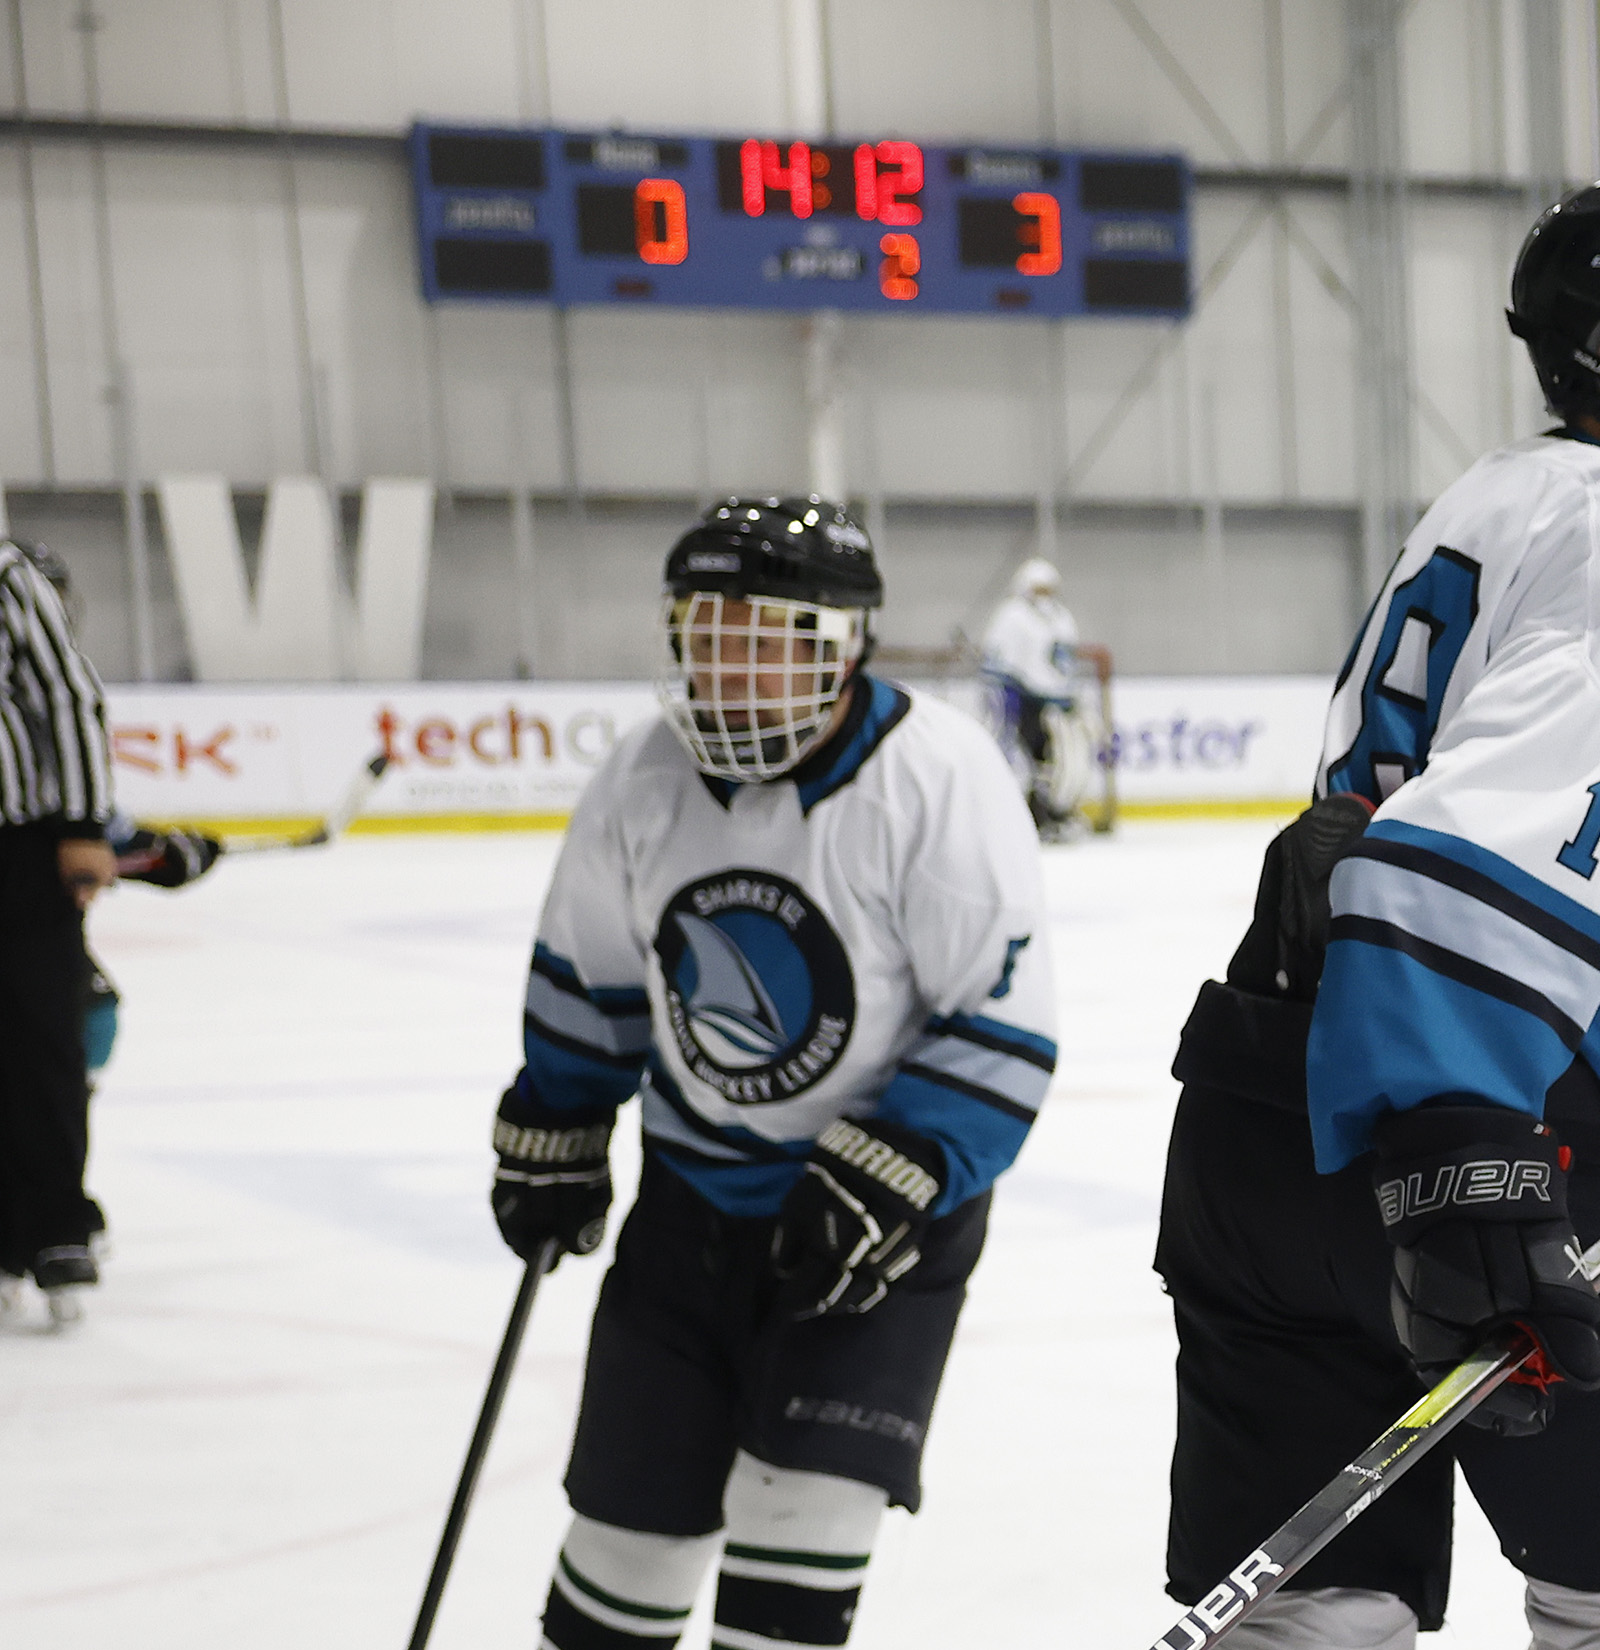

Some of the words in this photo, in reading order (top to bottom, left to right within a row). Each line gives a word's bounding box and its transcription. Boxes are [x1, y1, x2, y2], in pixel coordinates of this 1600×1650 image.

[634, 179, 687, 264] 0
[740, 139, 923, 225] 14:12
[1013, 193, 1062, 275] 3
[1375, 1160, 1552, 1228] AUER
